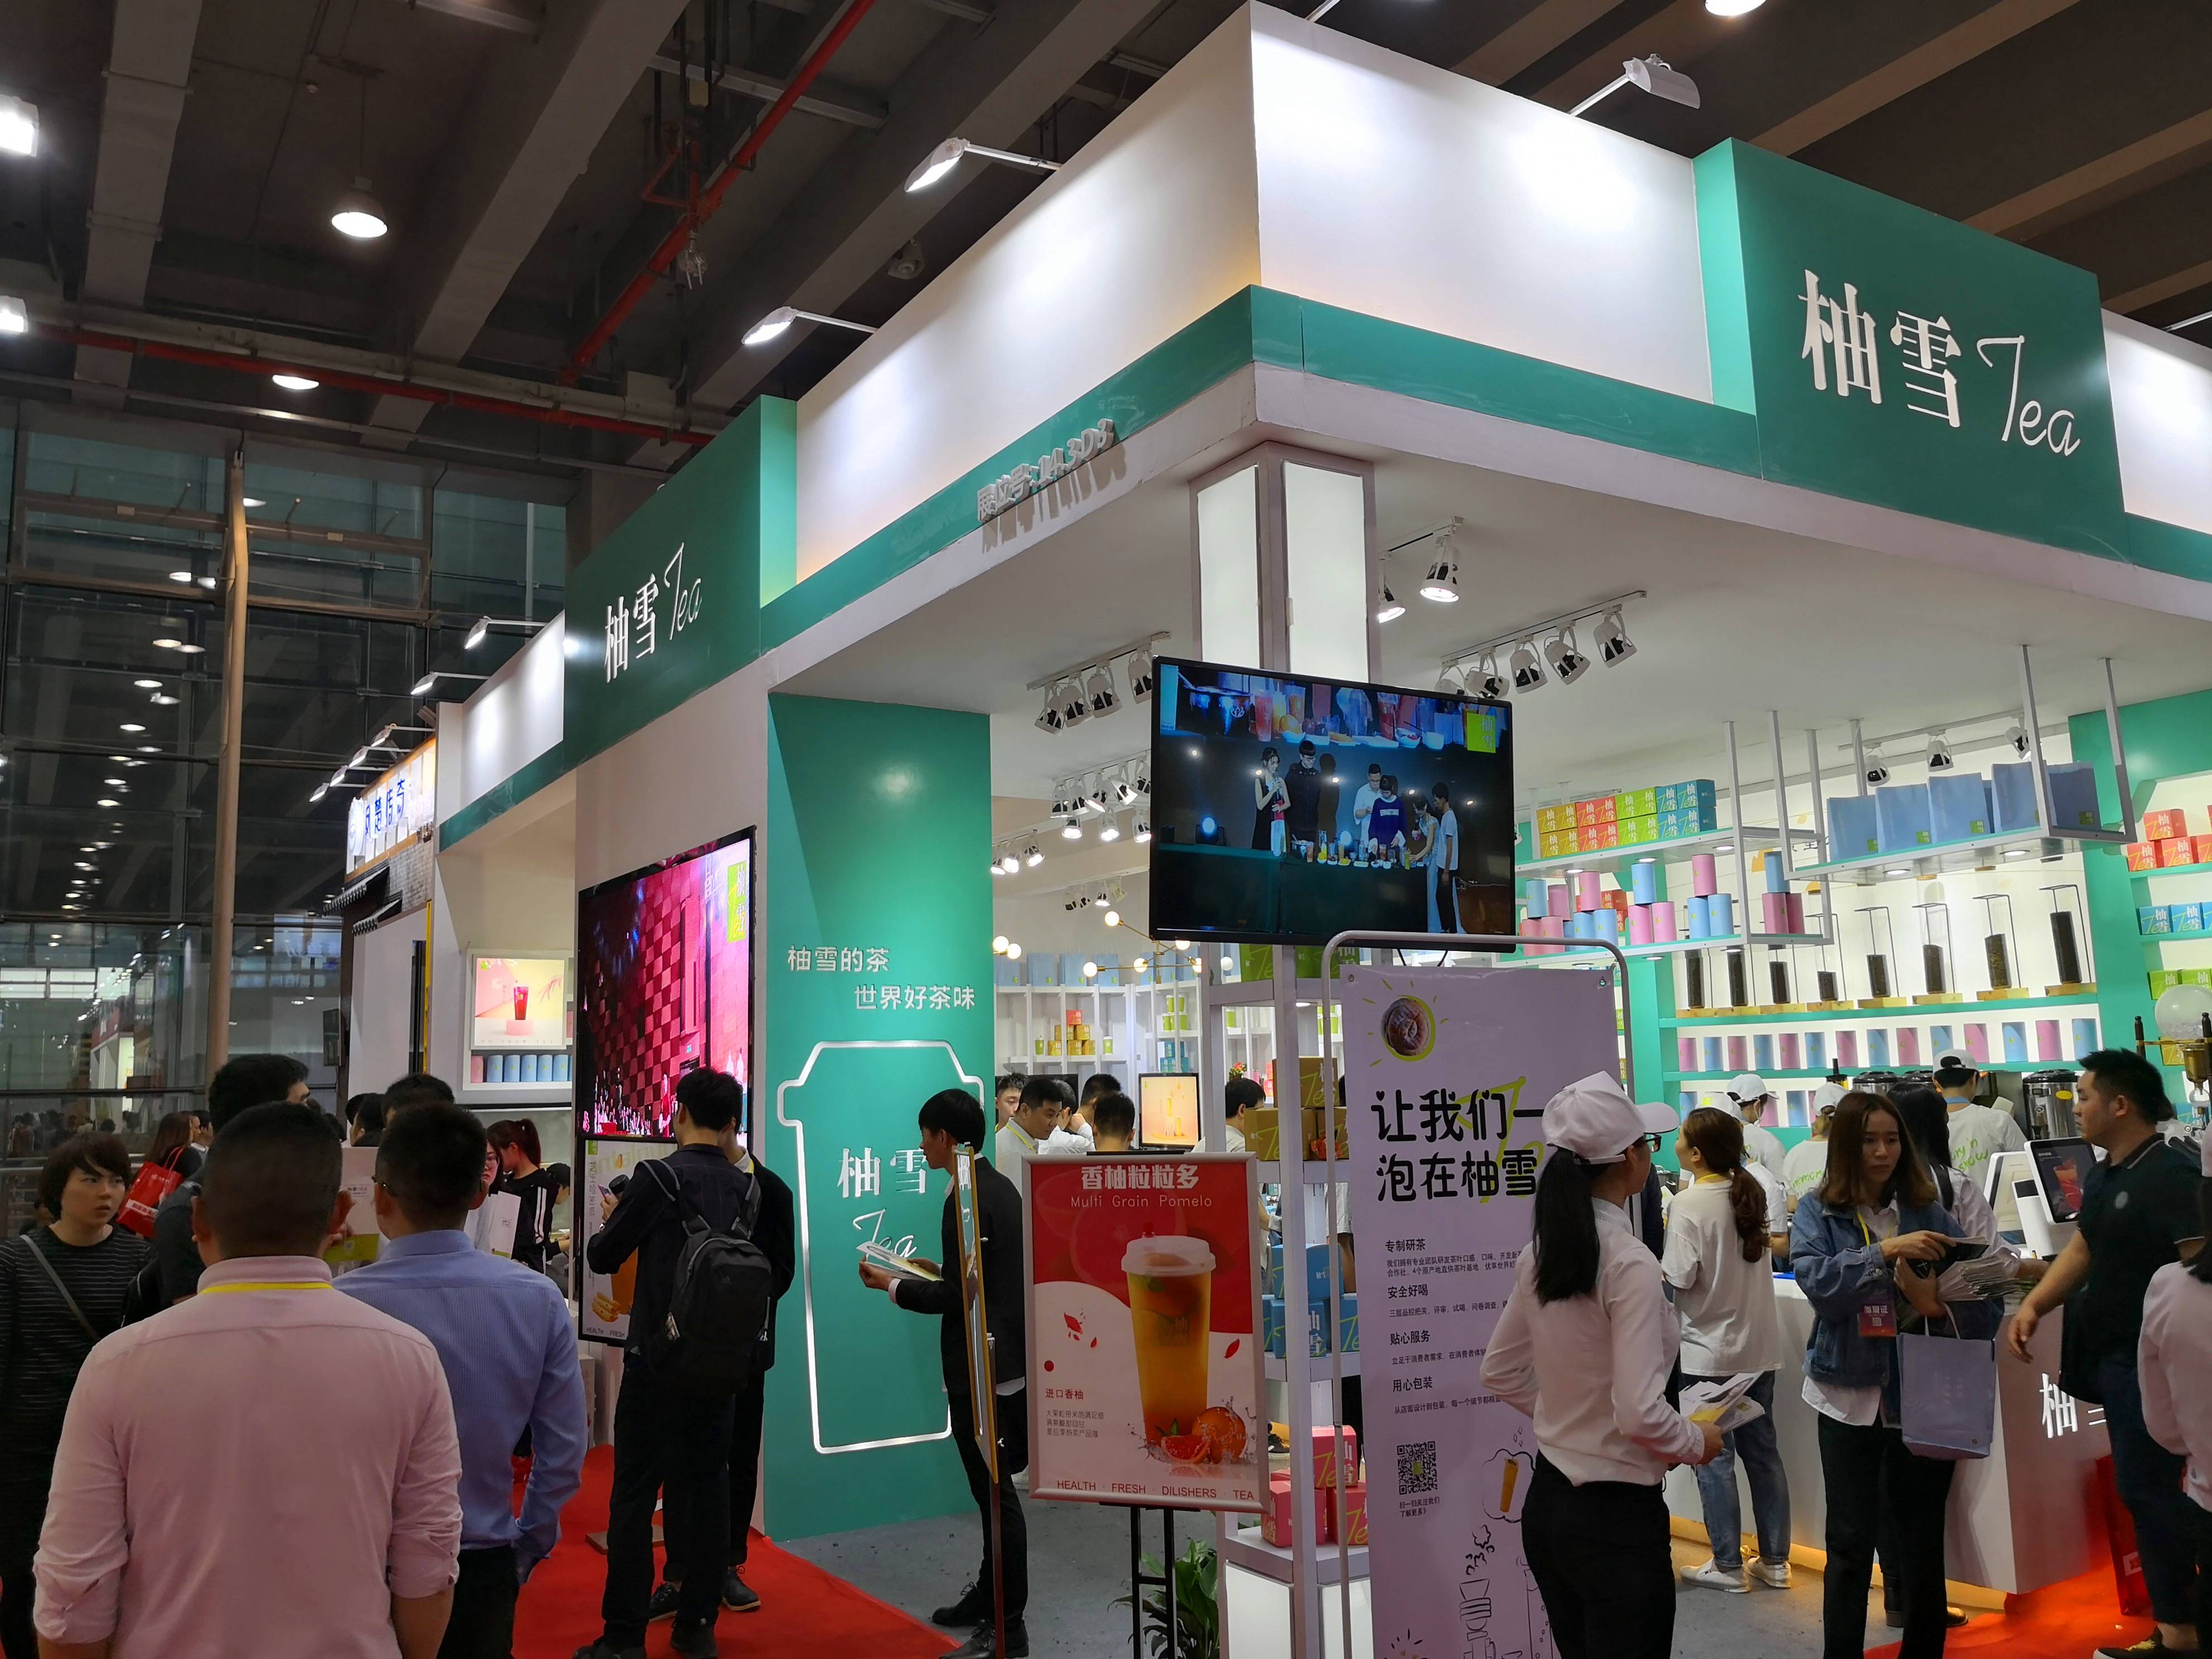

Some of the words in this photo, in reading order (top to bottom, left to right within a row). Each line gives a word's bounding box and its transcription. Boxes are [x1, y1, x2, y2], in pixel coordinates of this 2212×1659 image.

[1798, 269, 1961, 428] 柚雪
[1977, 335, 2081, 456] Tea
[604, 573, 659, 683] 柚雪
[664, 542, 702, 641] Tea
[788, 945, 890, 972] 柚雪的茶
[854, 984, 976, 1010] 世界好茶味
[837, 1147, 928, 1198] 柚雪
[1081, 1163, 1199, 1190] 香柚粒粒多
[1376, 1149, 1537, 1202] 泡在柚雪
[1071, 1195, 1102, 1207] Multi
[1112, 1195, 1148, 1207] Grain
[1159, 1194, 1212, 1207] Pomelo
[1385, 1238, 1425, 1253] 专制研茶
[1388, 1283, 1428, 1299] 安全好喝
[1390, 1330, 1430, 1345] 贴心服务
[1046, 1388, 1084, 1400] 进口香柚
[1393, 1376, 1433, 1393] 用心包装
[1057, 1480, 1096, 1491] HEALTH
[1112, 1483, 1146, 1495] FRESH
[1162, 1486, 1217, 1498] DILISHERS
[1233, 1490, 1254, 1501] TEA
[1399, 1496, 1439, 1509] 扫一扫关注我们
